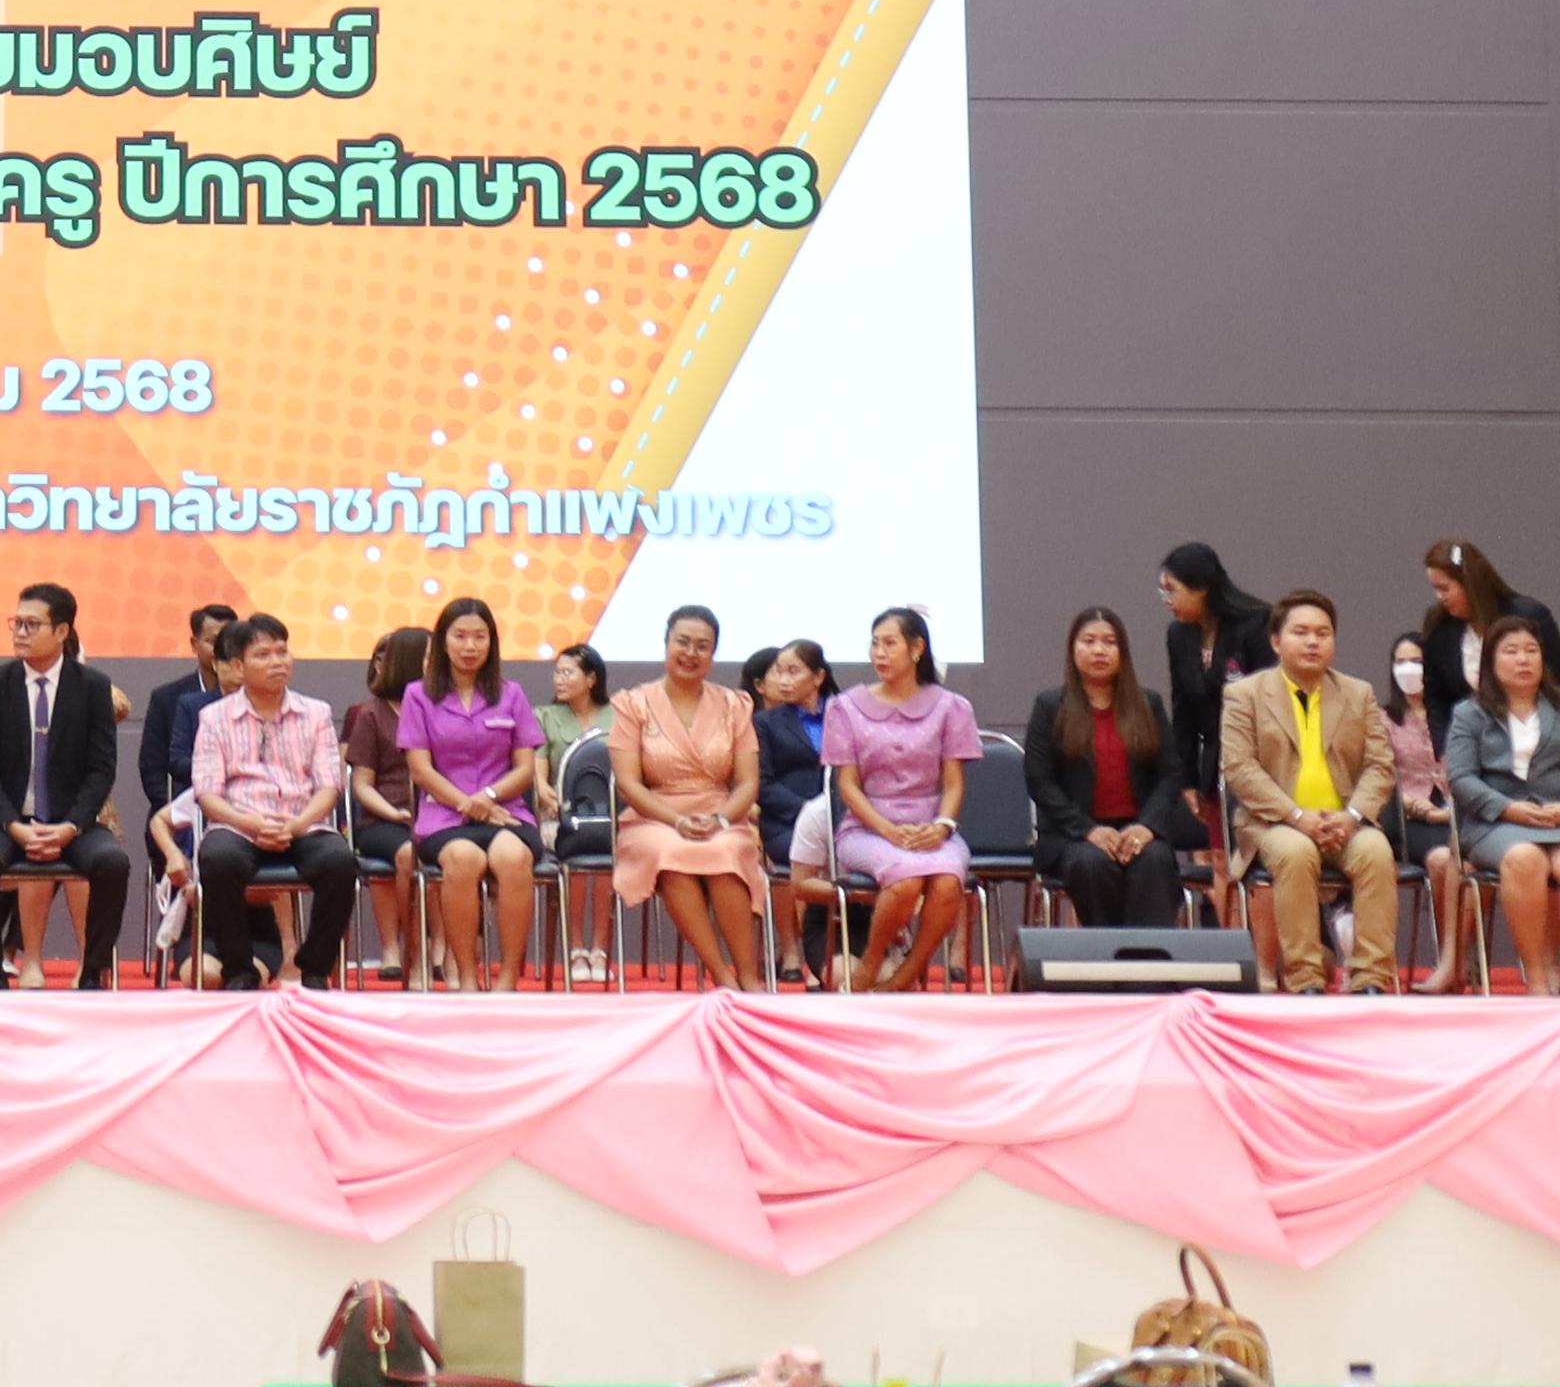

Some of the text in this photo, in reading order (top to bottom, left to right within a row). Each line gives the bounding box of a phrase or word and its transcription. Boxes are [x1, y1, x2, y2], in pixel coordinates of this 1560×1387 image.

[117, 130, 566, 226] ปีการศึกษา
[581, 147, 818, 228] 2568
[41, 358, 214, 413] 2568
